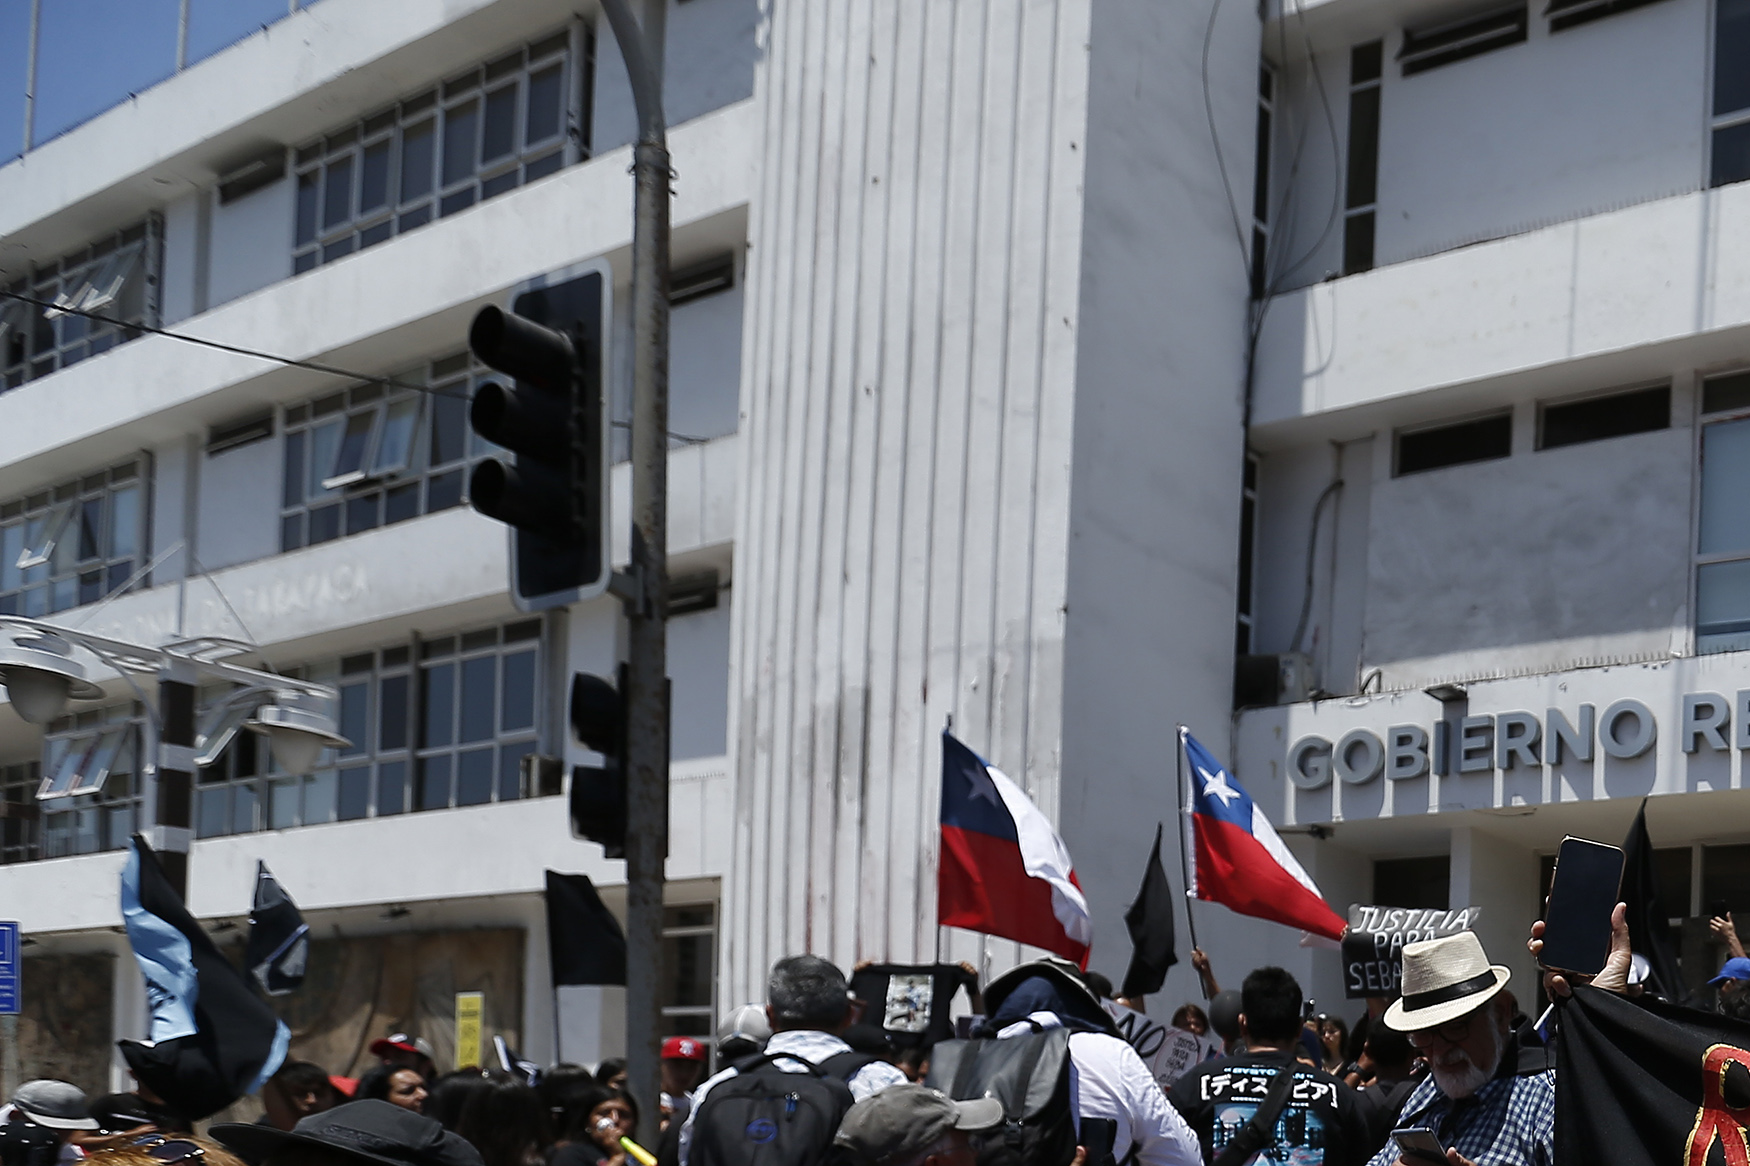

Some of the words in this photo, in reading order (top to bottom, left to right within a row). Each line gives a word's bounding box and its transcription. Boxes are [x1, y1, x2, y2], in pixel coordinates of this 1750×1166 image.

[1287, 697, 1657, 791] GOBIERNO
[1351, 906, 1473, 935] JUSTICIA
[1117, 1012, 1166, 1058] NO
[1201, 1074, 1339, 1109] [ディスピア]
